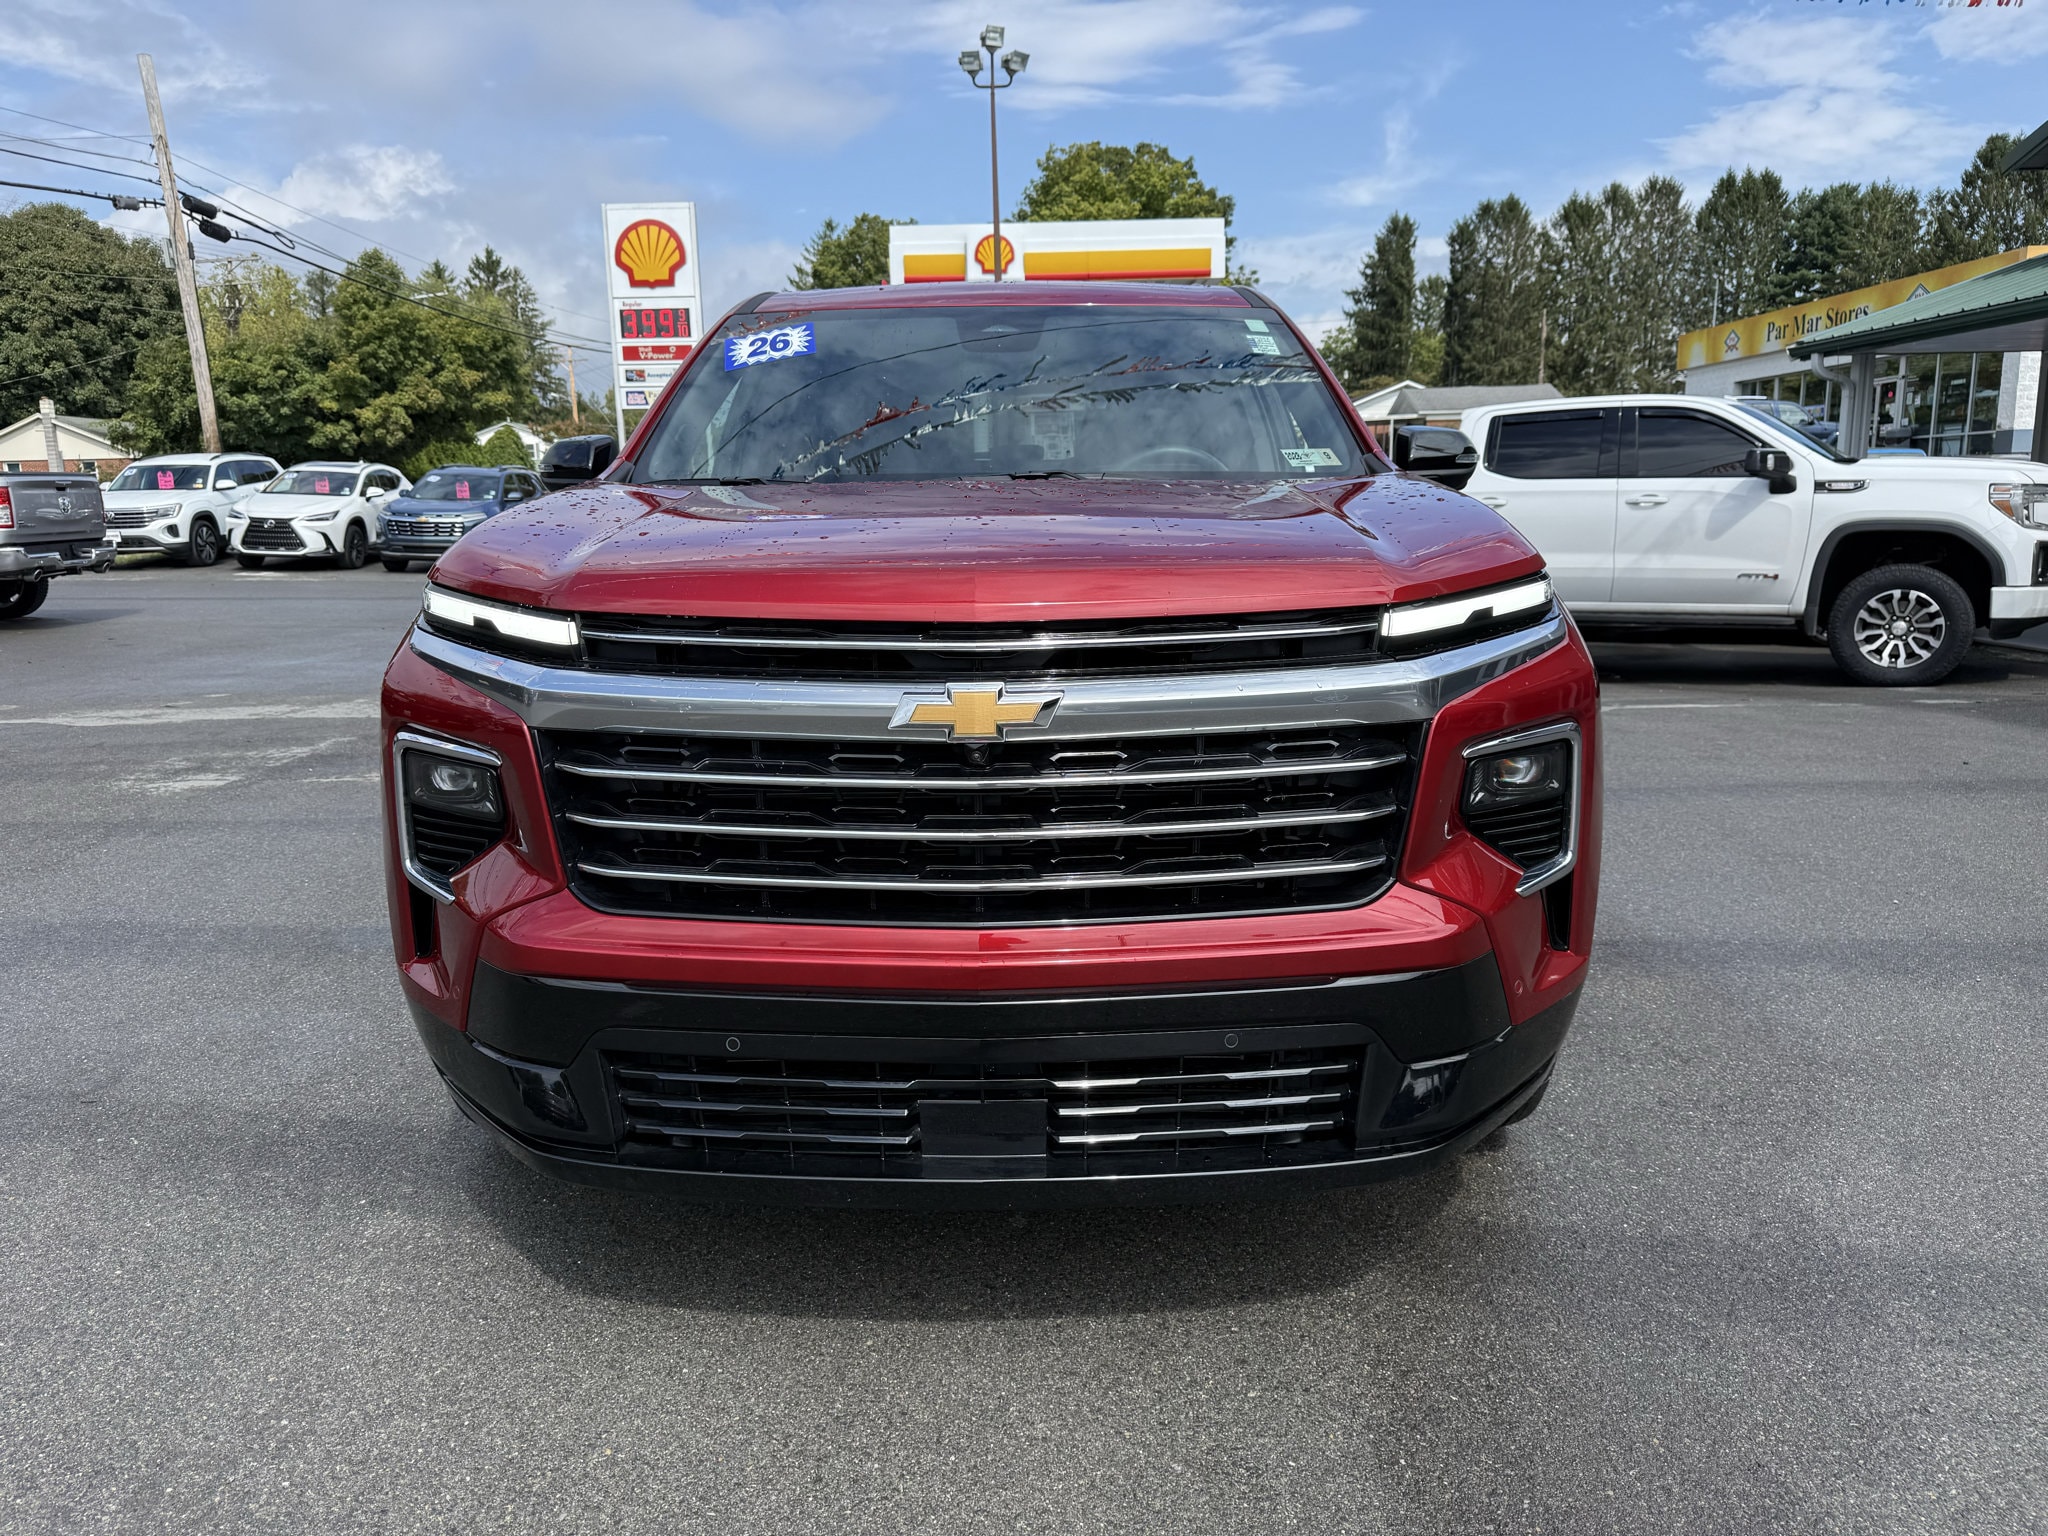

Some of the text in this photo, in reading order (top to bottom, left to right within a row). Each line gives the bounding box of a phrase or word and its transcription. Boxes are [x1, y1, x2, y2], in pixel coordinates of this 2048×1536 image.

[623, 309, 674, 338] 3.99
[1767, 304, 1870, 342] Par Mar Stores
[639, 352, 673, 360] V-Power
[747, 332, 790, 358] 26
